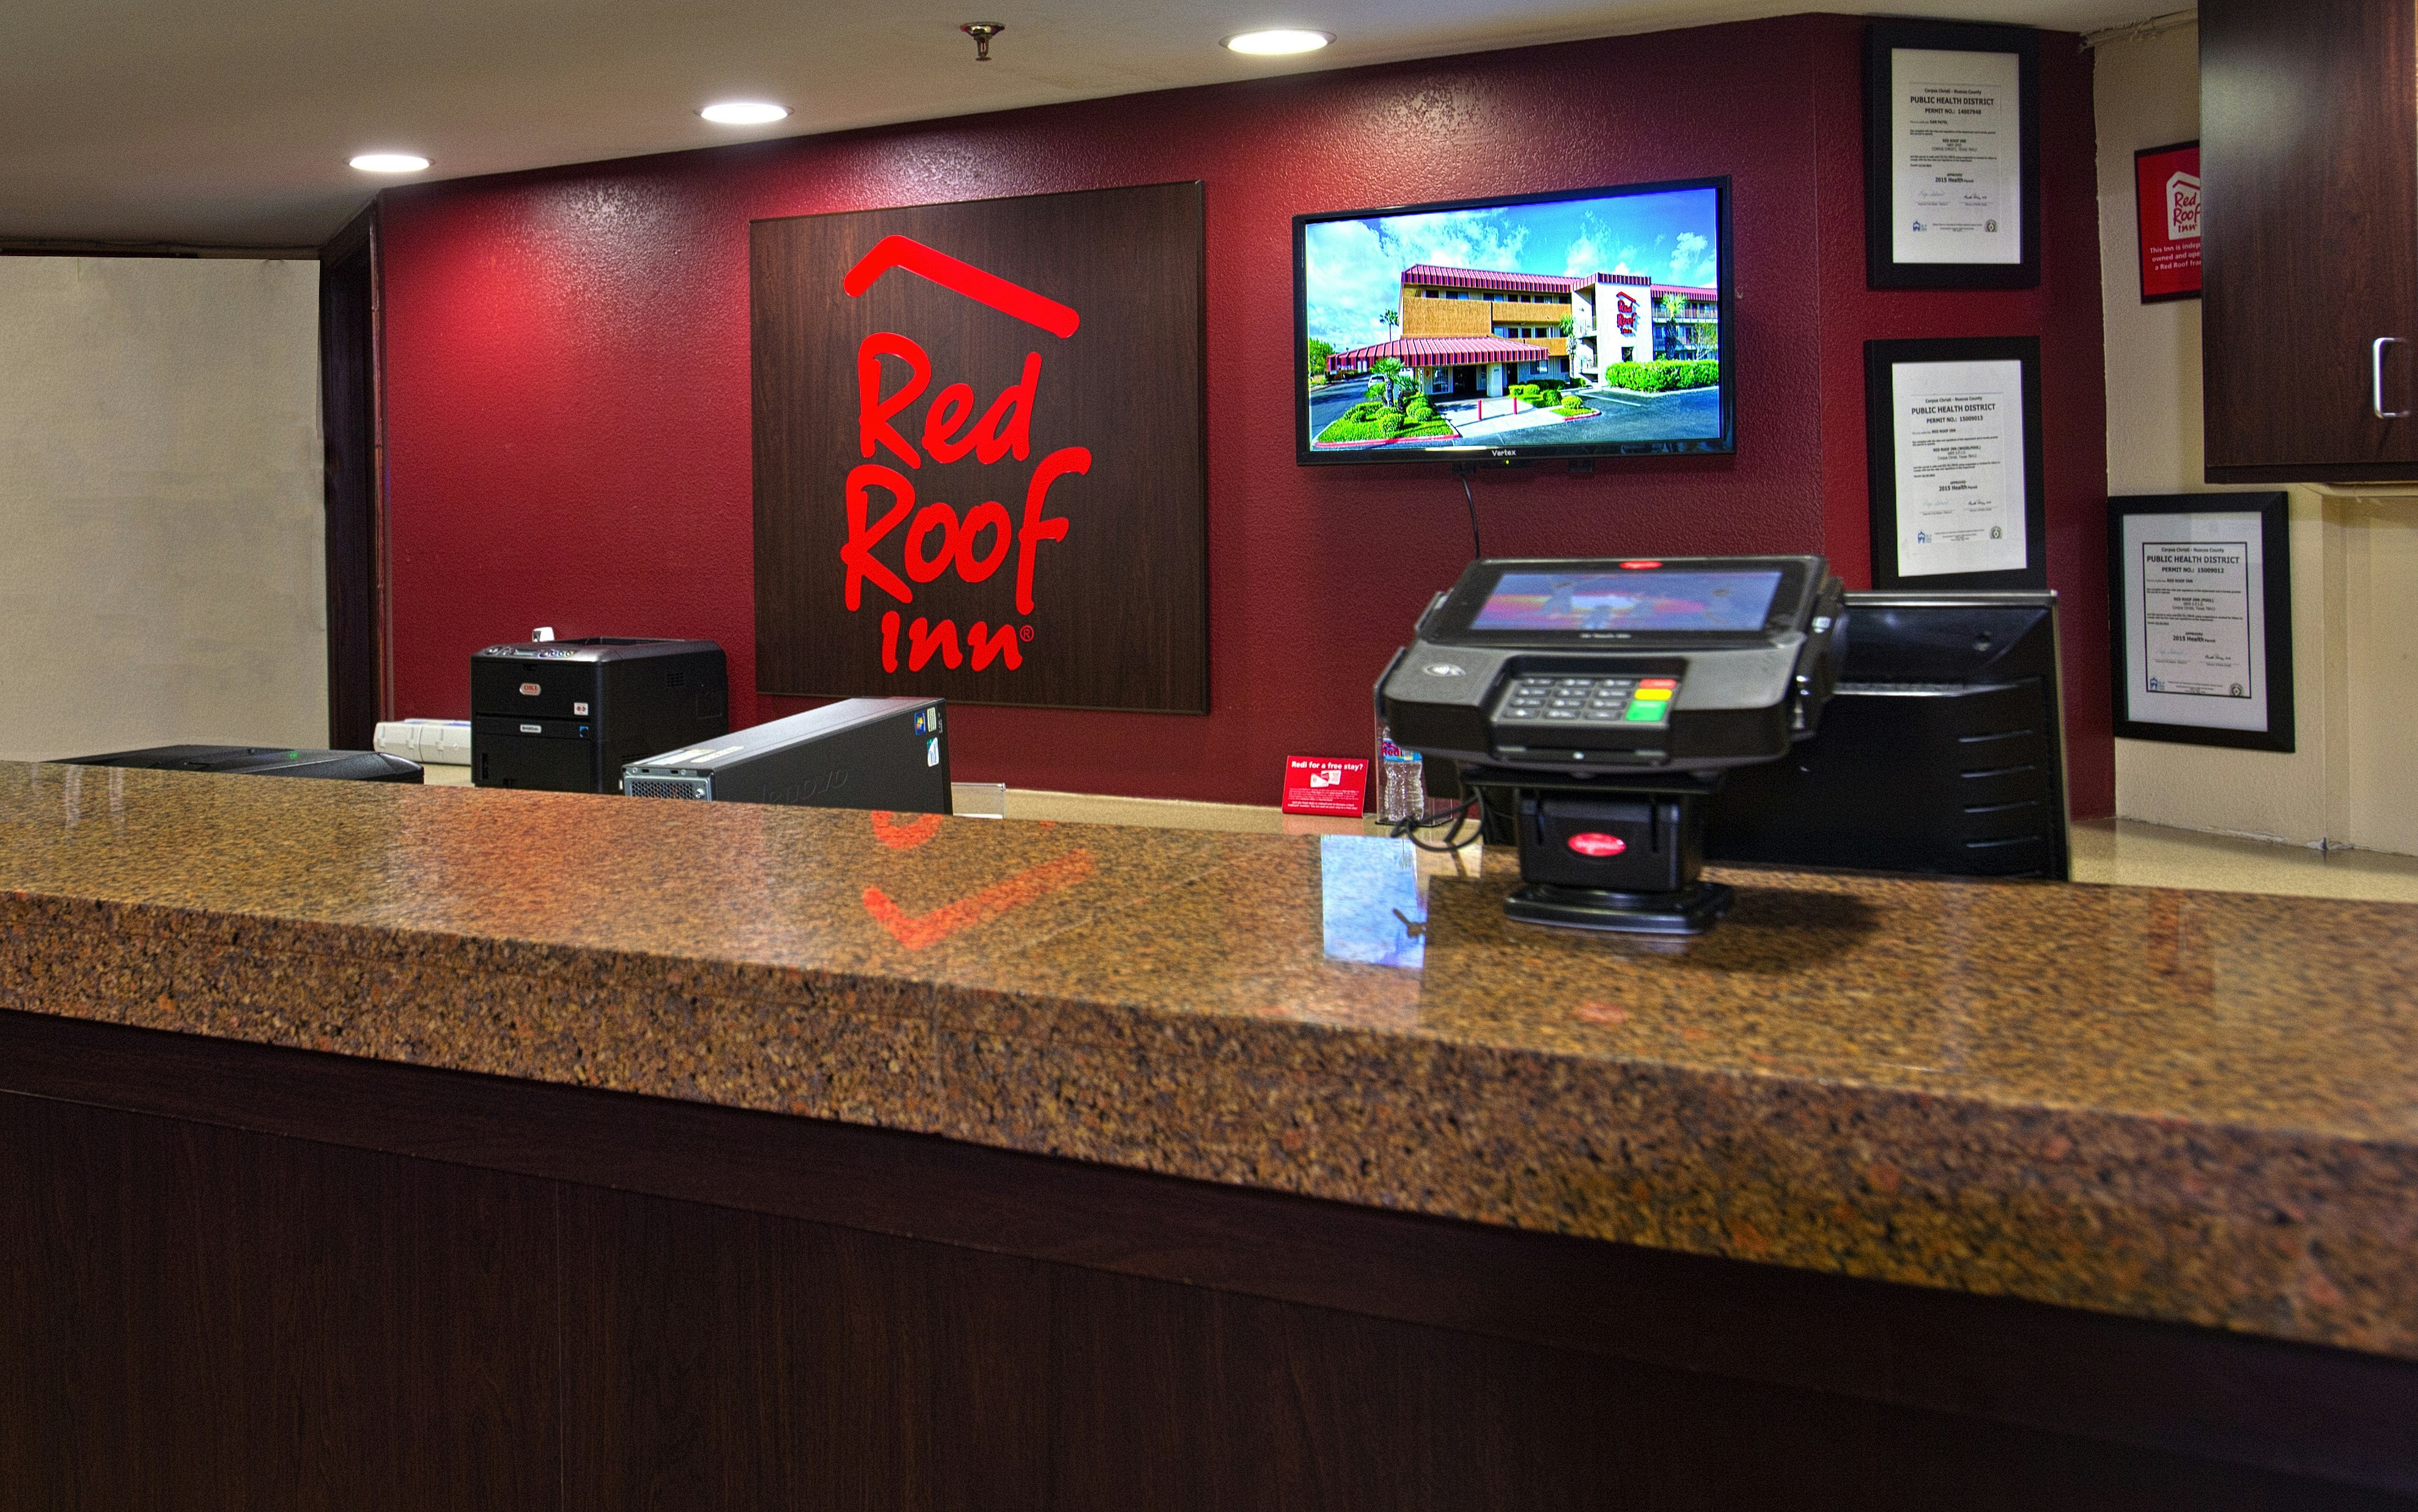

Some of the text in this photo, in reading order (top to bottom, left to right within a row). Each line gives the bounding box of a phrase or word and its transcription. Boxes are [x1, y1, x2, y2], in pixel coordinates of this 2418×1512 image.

[2175, 191, 2197, 208] Red
[2173, 203, 2201, 226] Roof
[858, 331, 1042, 469] Red
[839, 446, 1092, 616] Roof
[1328, 761, 1342, 770] free
[1344, 763, 1363, 772] stay?
